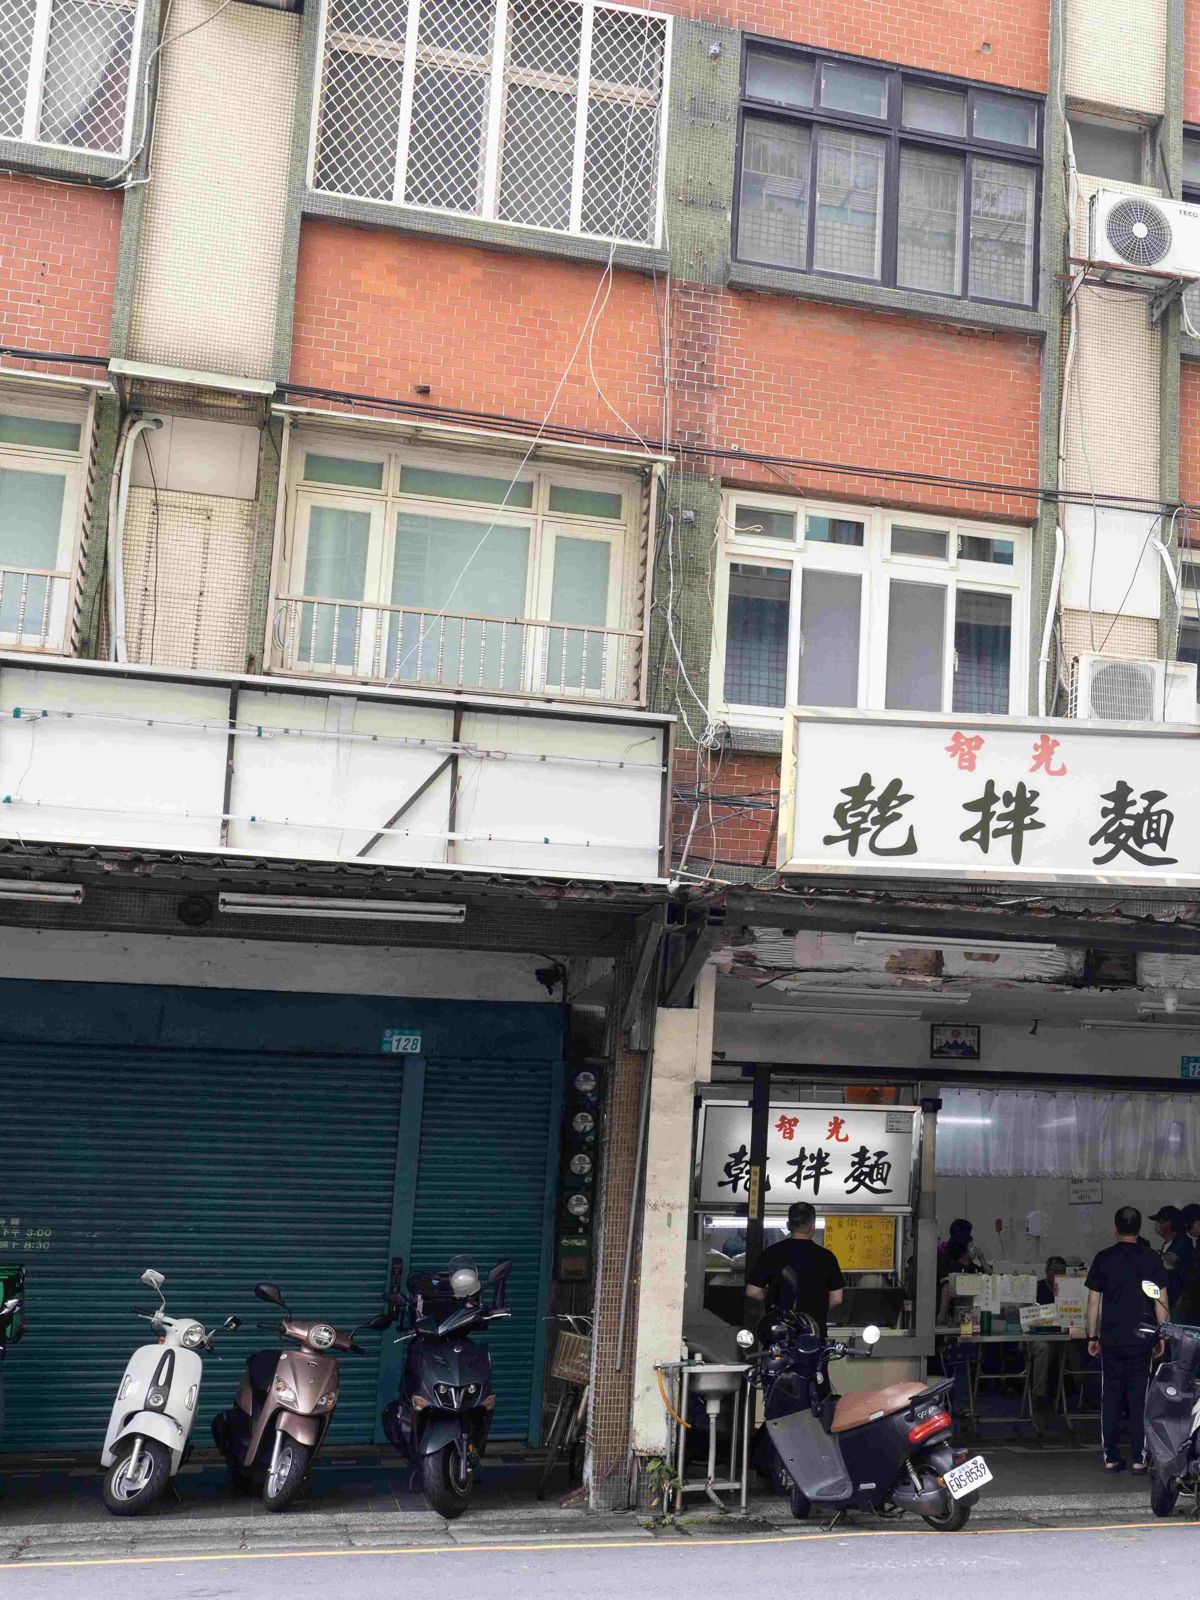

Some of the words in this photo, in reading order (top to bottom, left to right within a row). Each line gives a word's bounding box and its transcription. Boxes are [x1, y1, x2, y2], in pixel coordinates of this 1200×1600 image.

[1179, 209, 1199, 218] TECO
[945, 731, 1068, 777] 智光
[822, 773, 1179, 867] 乾拌麵
[395, 1037, 420, 1051] 128
[775, 1115, 849, 1143] 智光
[717, 1144, 893, 1196] 乾拌麵
